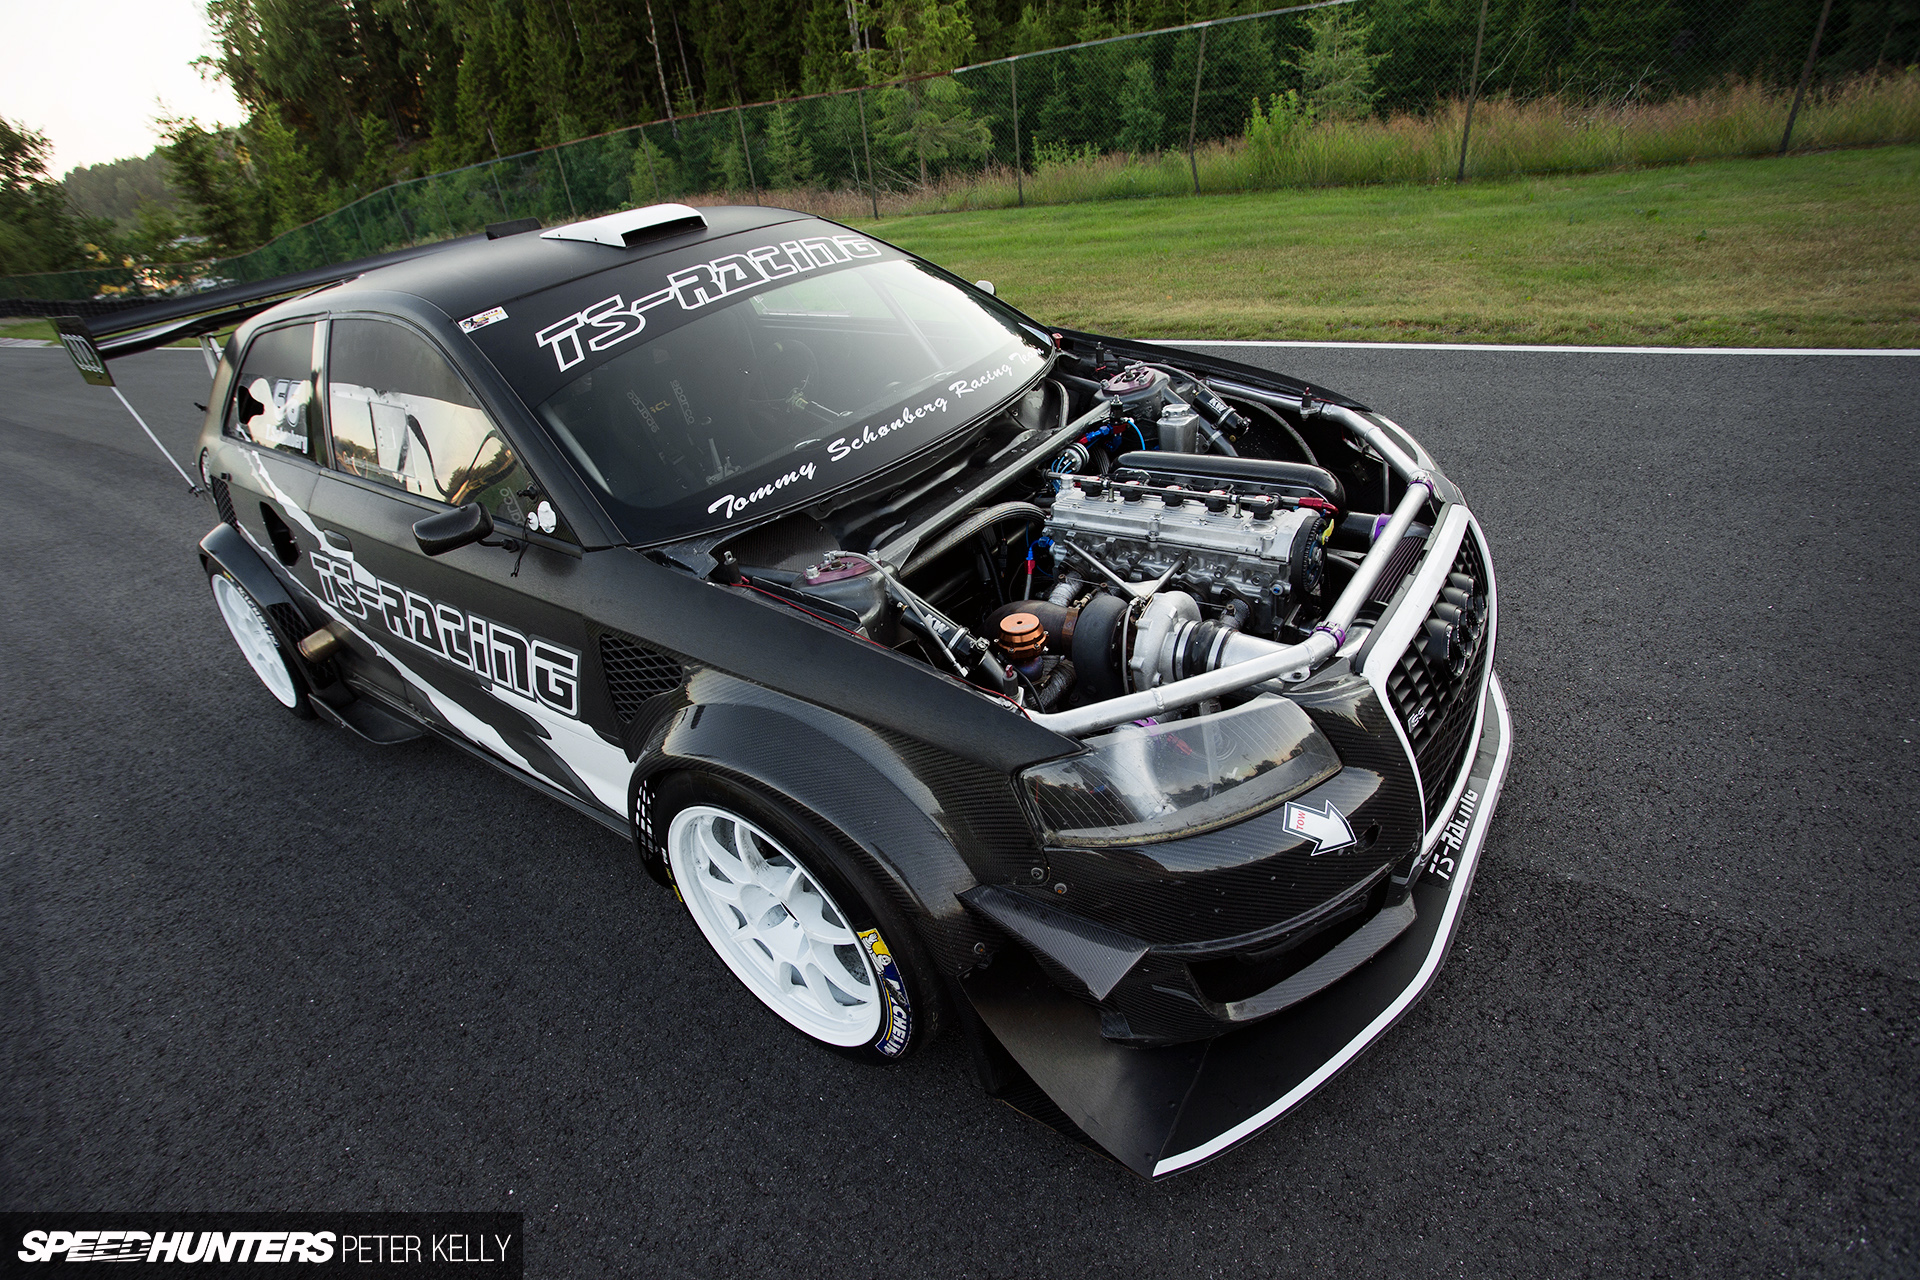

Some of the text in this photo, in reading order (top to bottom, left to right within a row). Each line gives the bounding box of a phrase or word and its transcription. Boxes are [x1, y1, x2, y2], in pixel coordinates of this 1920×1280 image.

[1208, 397, 1228, 412] KW
[708, 462, 816, 519] Tommy
[827, 397, 947, 462] Schønberg
[949, 364, 1012, 398] Racing
[924, 613, 950, 635] KW
[1296, 810, 1305, 830] TOW
